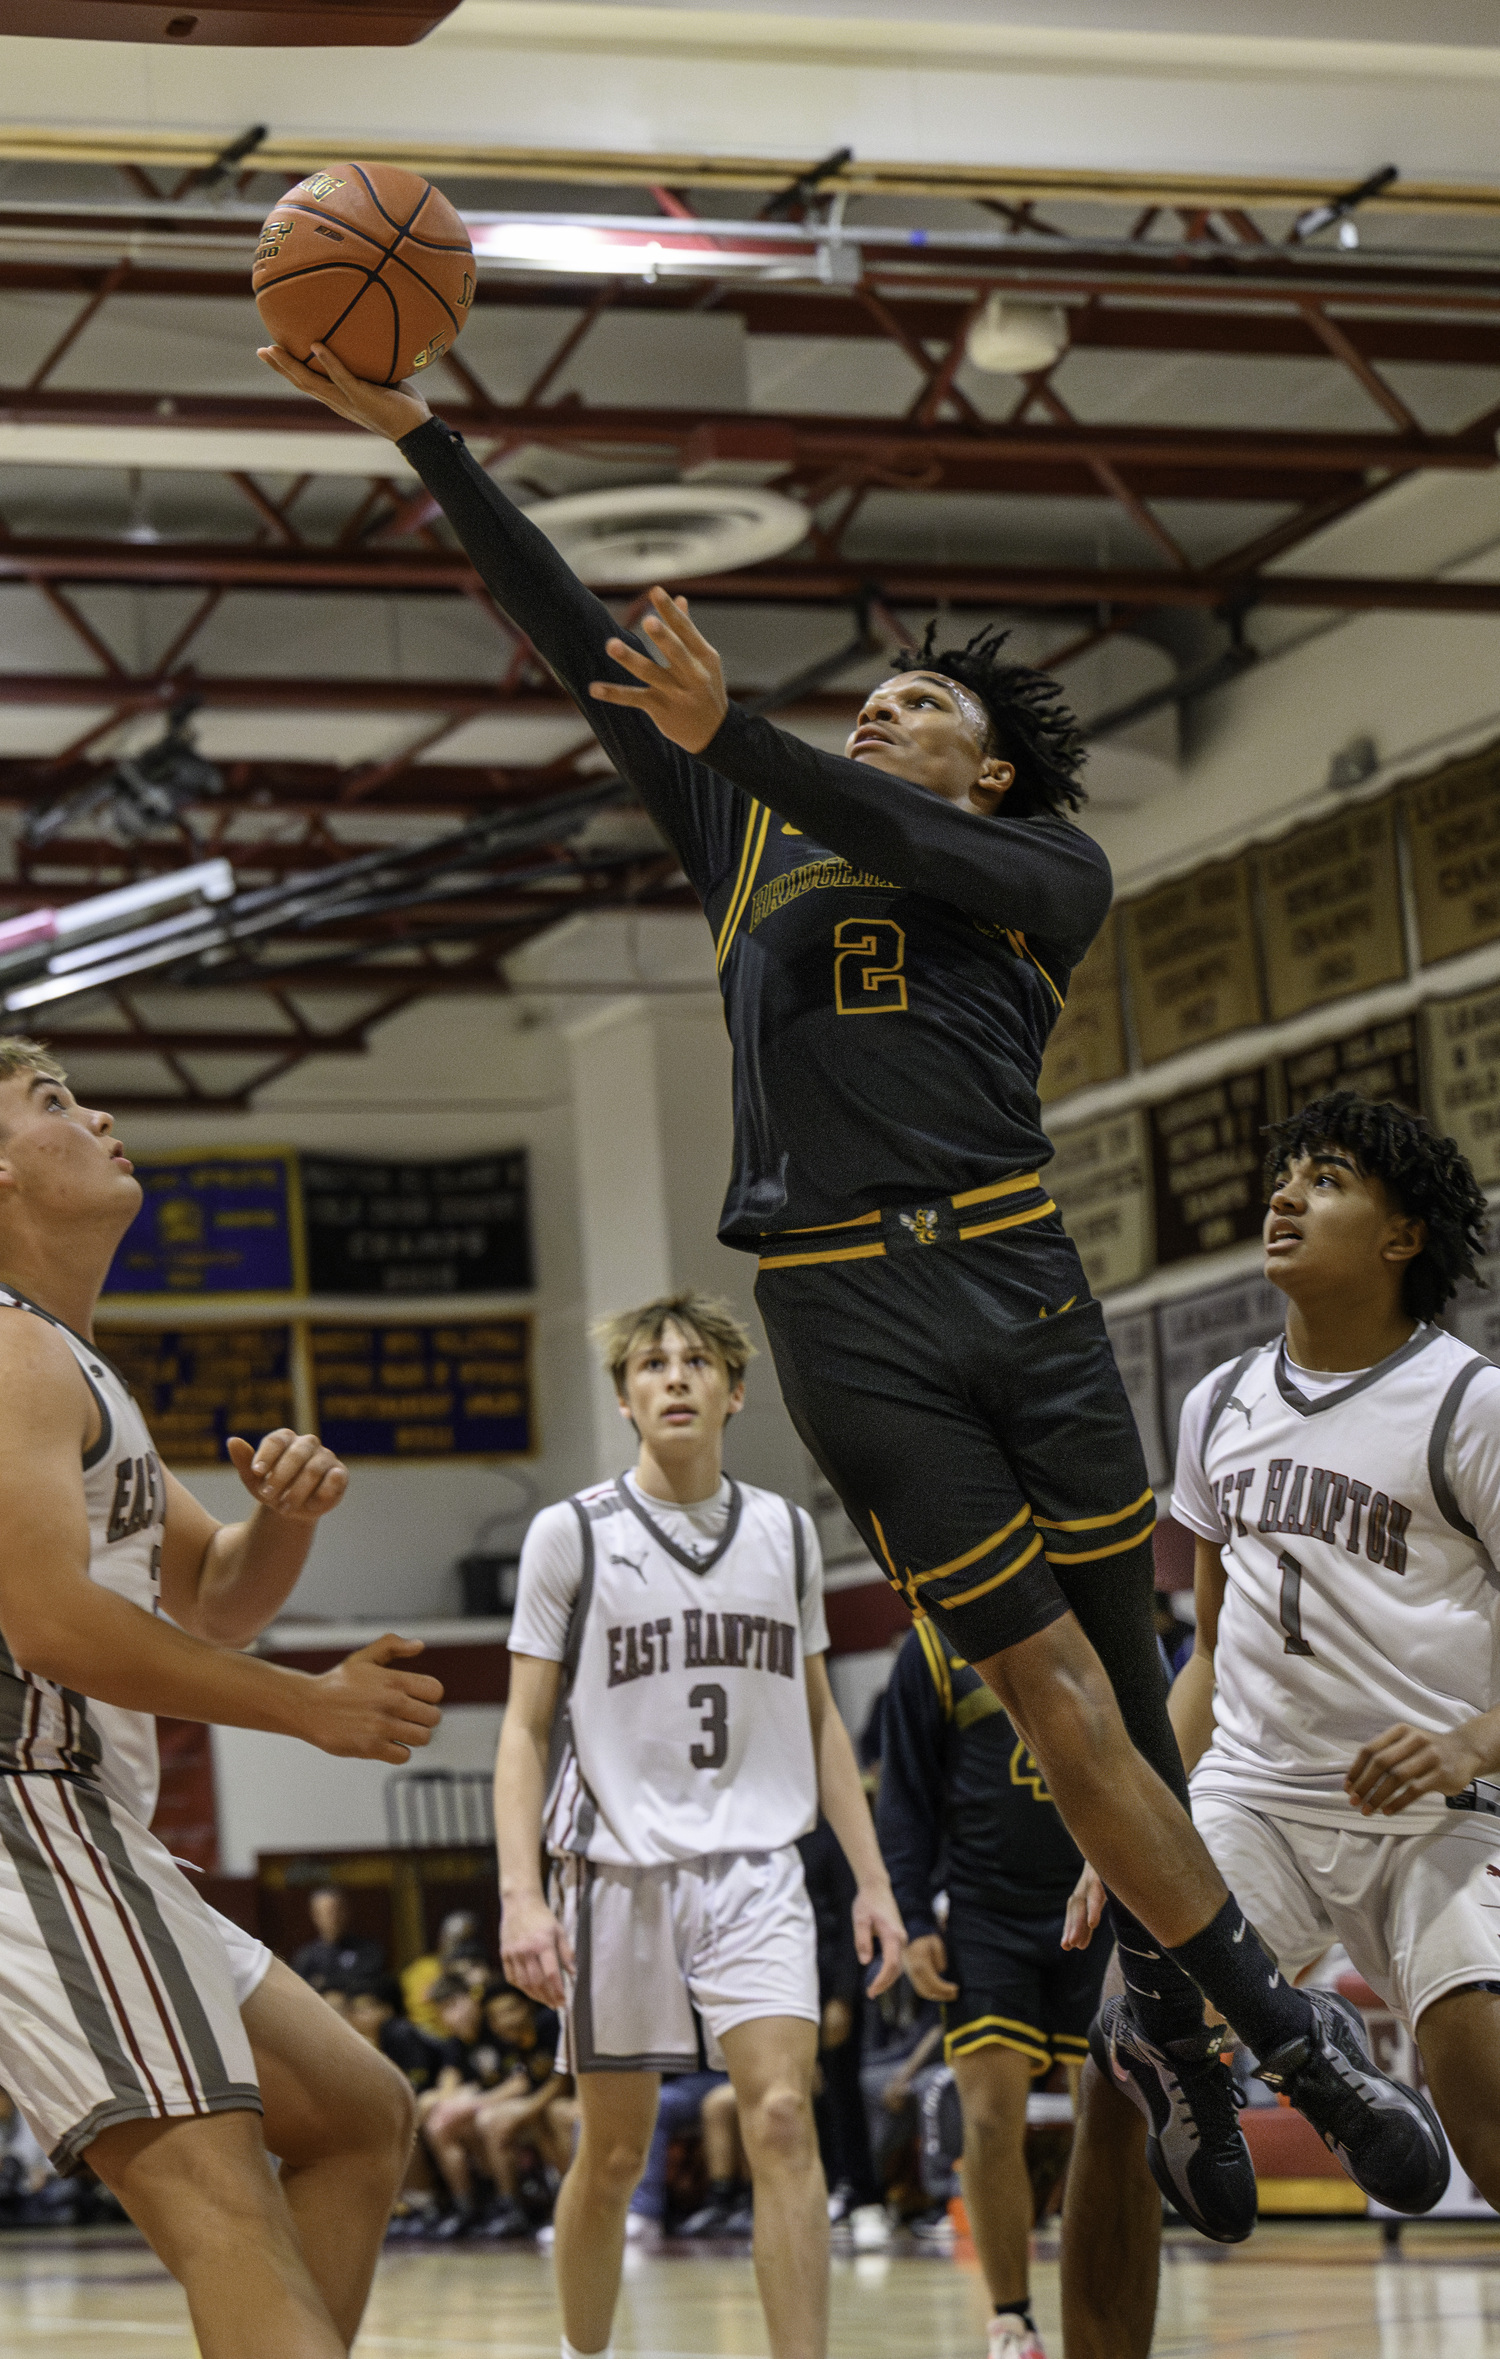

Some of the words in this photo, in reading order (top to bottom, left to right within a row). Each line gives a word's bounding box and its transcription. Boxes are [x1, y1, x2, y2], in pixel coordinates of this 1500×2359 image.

[749, 856, 904, 934] BRIDGE
[833, 917, 908, 1015] 2
[1258, 1458, 1412, 1575] HAMPTON
[607, 1617, 672, 1688] EAST
[683, 1608, 796, 1679] HAMPTON
[1277, 1550, 1315, 1656] 1
[689, 1683, 728, 1769] 3
